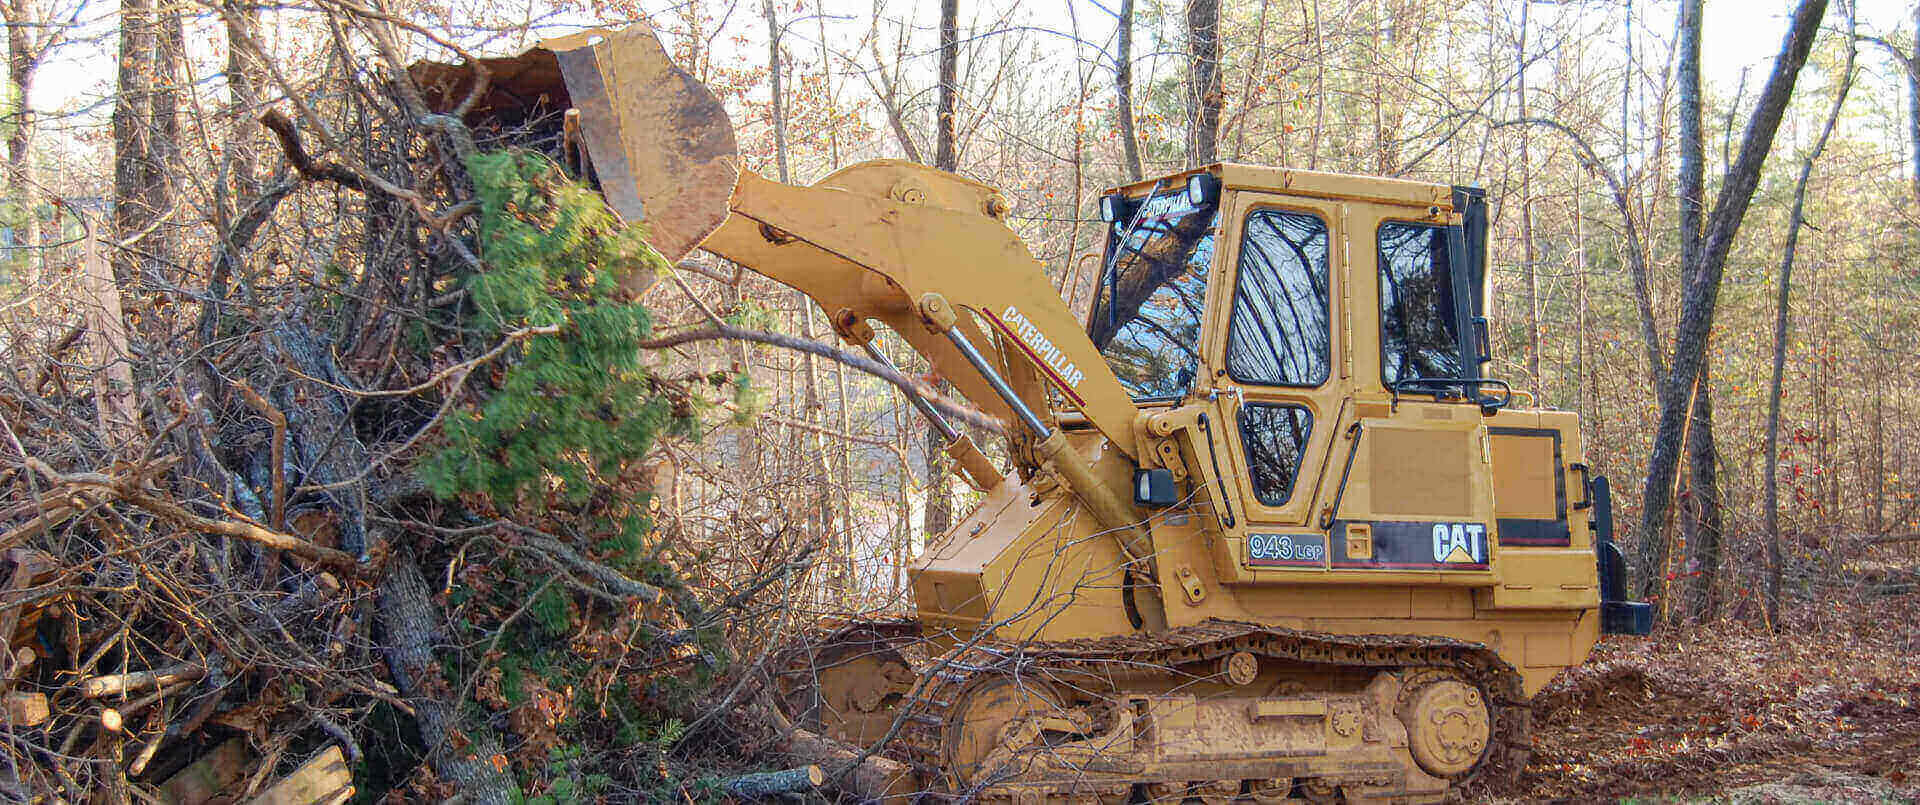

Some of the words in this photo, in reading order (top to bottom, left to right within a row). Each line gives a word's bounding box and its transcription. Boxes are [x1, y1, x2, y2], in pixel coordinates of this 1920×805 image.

[1002, 305, 1084, 388] CATERPILLAR
[1250, 535, 1293, 560] 943
[1295, 544, 1323, 560] LGP
[1432, 524, 1483, 563] CAT
